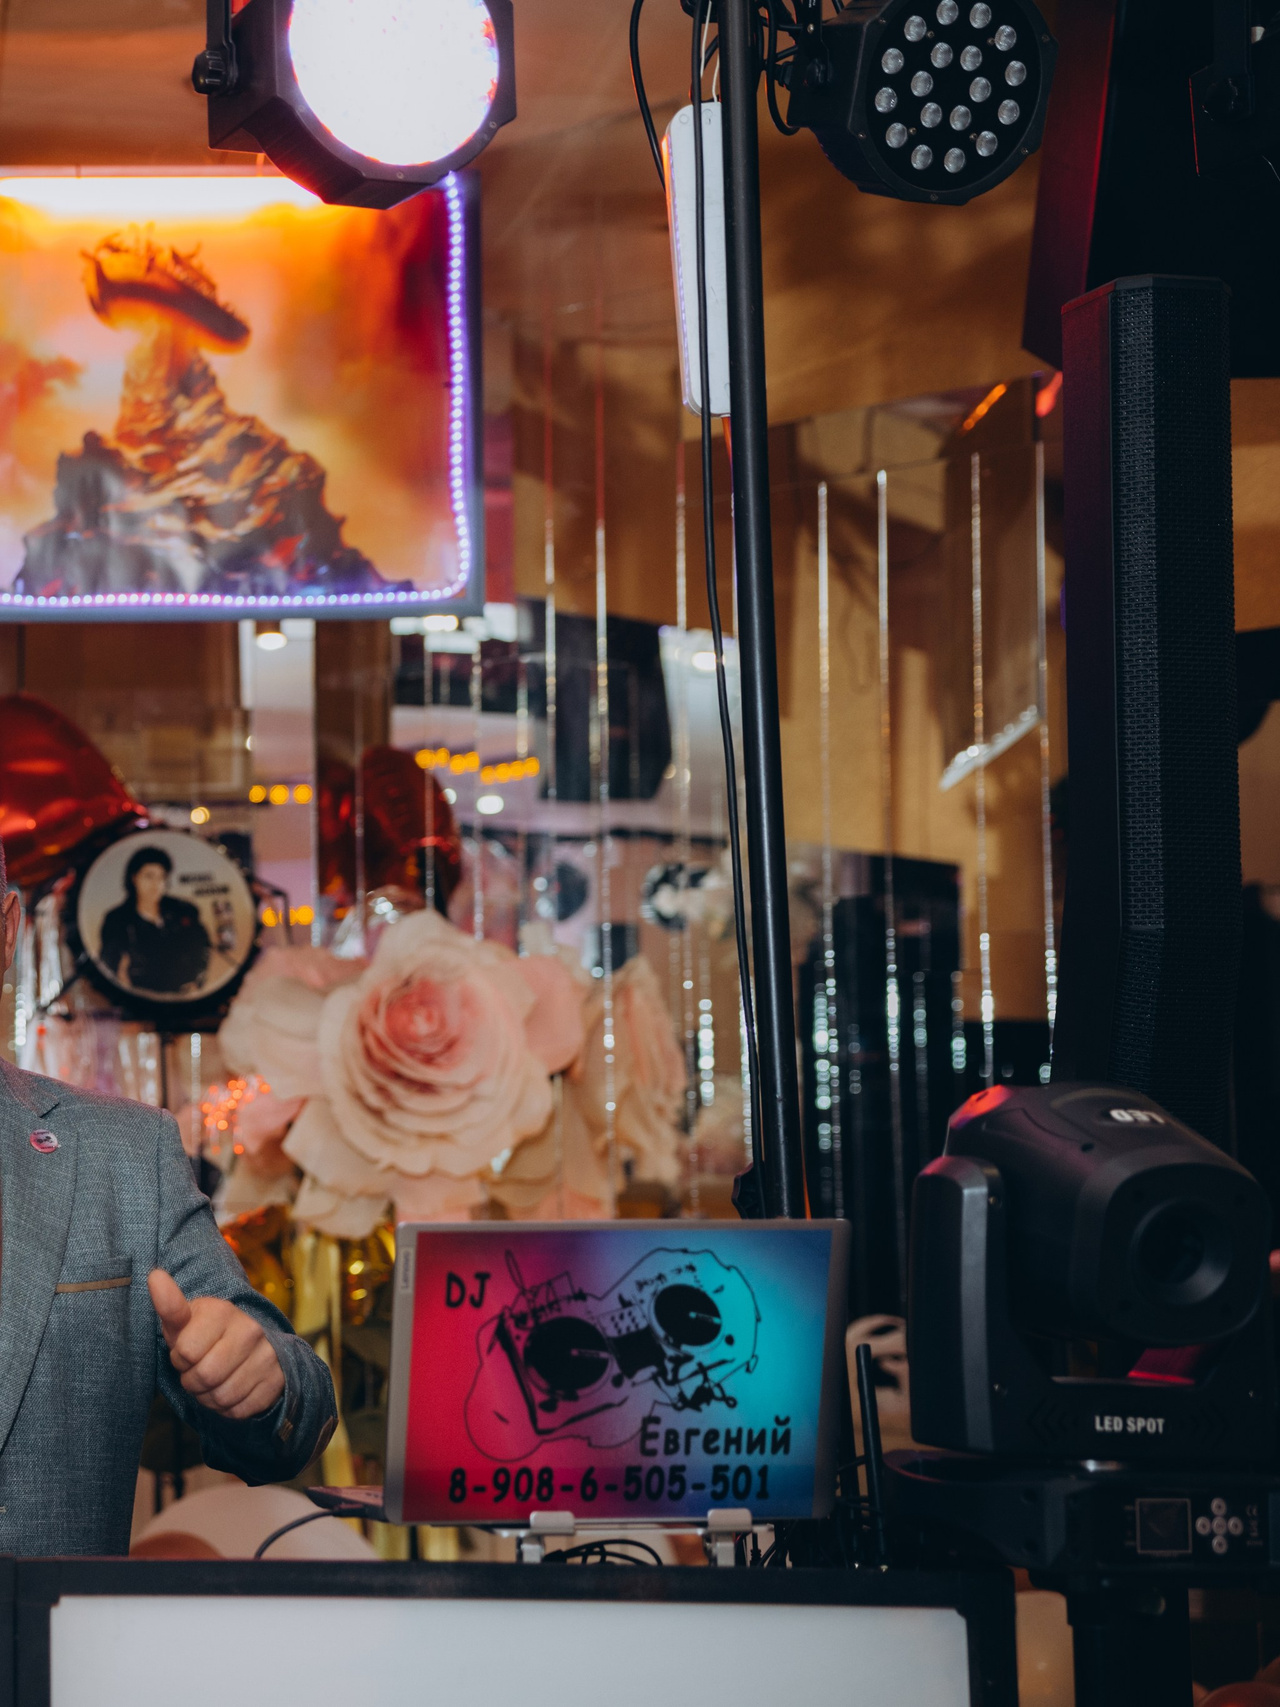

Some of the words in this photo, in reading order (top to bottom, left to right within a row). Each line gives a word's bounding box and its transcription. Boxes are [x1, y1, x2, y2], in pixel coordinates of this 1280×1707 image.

[1110, 1109, 1166, 1124] LED
[445, 1272, 491, 1309] DJ
[639, 1415, 792, 1457] Евгений
[1094, 1415, 1123, 1432] LED
[1126, 1416, 1165, 1434] SPOT
[448, 1465, 769, 1502] 8-908-6-505-501
